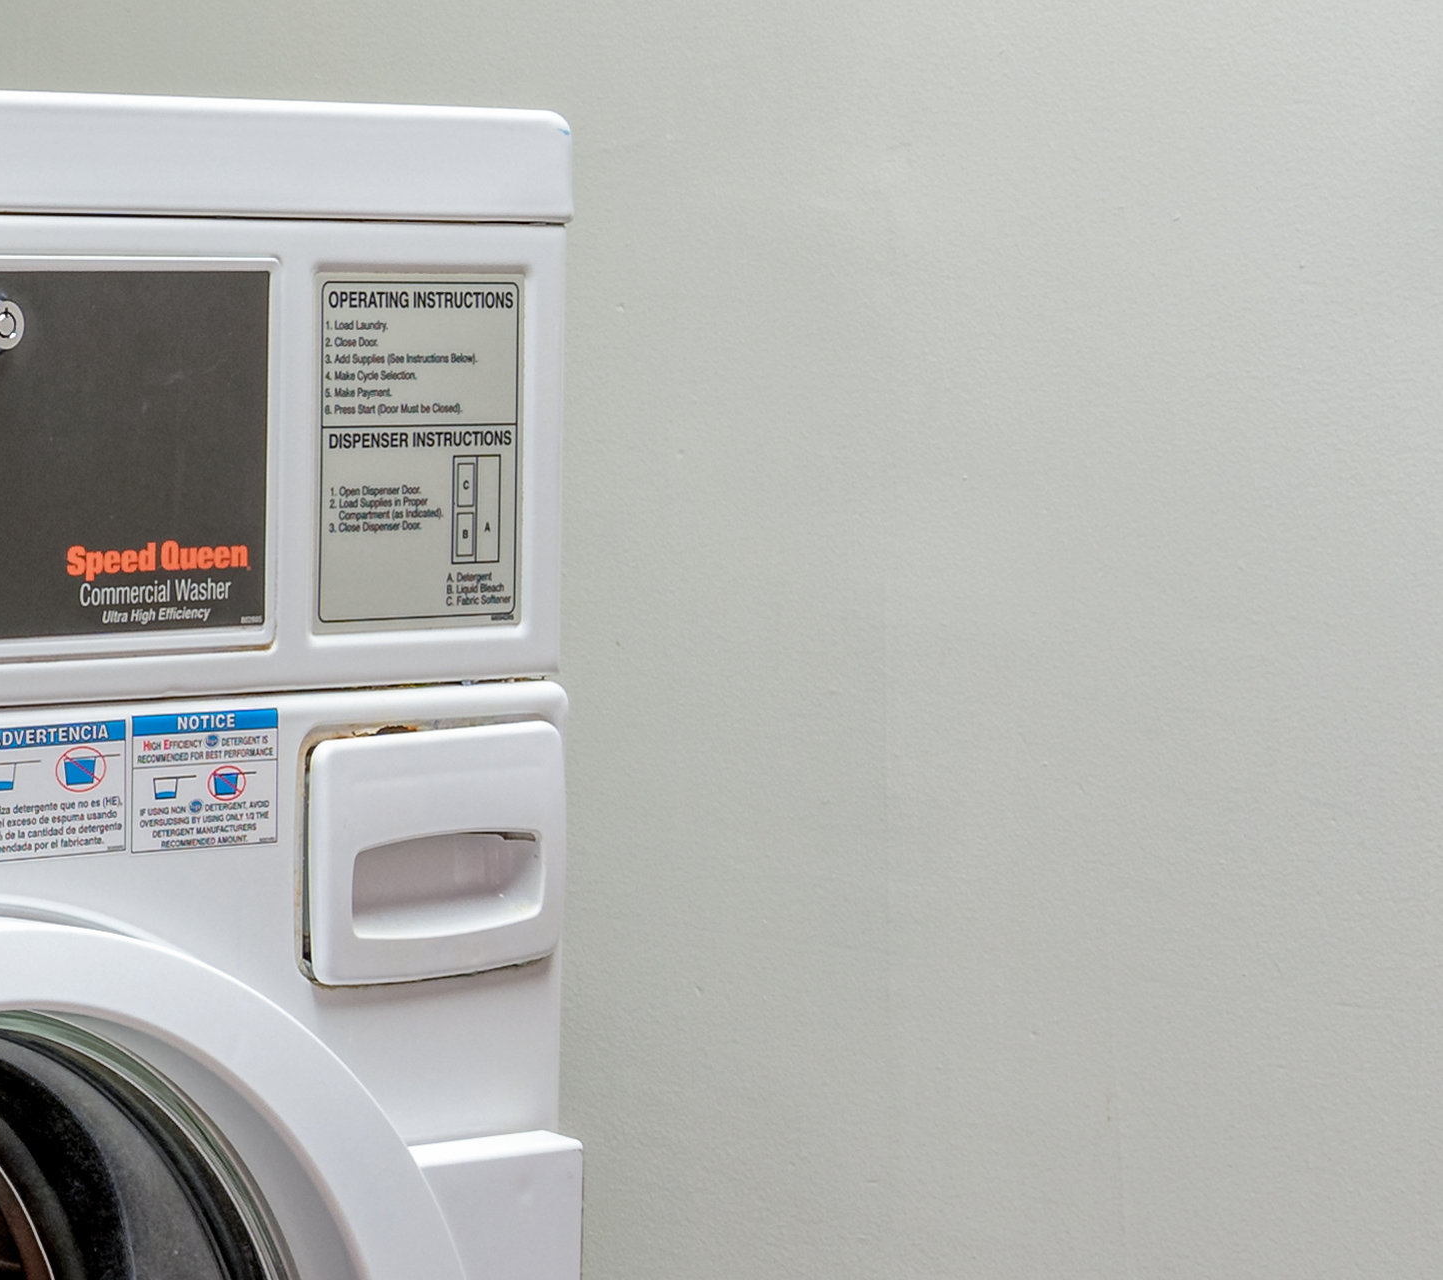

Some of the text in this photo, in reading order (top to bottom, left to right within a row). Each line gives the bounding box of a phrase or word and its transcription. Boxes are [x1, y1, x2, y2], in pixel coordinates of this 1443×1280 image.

[329, 291, 513, 309] OPERATING INSTRUCTIONS
[326, 321, 388, 332] 1. Load Laundry.
[325, 338, 332, 347] 2.
[335, 337, 356, 347] Close
[325, 355, 332, 364] 3.
[334, 354, 350, 364] Add
[352, 354, 385, 365] Supplies
[387, 354, 404, 365] (See
[407, 353, 449, 363] Instructions
[325, 372, 332, 380] 4.
[335, 371, 355, 380] Make
[357, 371, 378, 383] Cycle
[335, 388, 355, 397] Make
[335, 404, 355, 414] Press
[358, 404, 375, 414] Start
[378, 404, 398, 415] (Door
[401, 404, 419, 413] Must
[421, 404, 430, 413] be
[329, 431, 512, 449] DISPENSER INSTRUCTIONS
[463, 481, 469, 489] C
[339, 487, 360, 497] Open
[362, 486, 400, 497] Dispenser
[330, 498, 428, 509] 2. Load Supplies in Proper
[339, 511, 390, 521] Compartment
[329, 524, 337, 533] 3.
[339, 523, 360, 533] Close
[363, 522, 400, 533] Dispenser
[485, 523, 490, 532] A
[463, 530, 468, 539] B
[66, 540, 248, 581] Speed Queen
[447, 572, 492, 583] A. Detergent
[79, 578, 231, 606] Commercial Washer
[447, 583, 504, 595] B. Liquid Bleach
[446, 595, 511, 606] C. Fabric Softener
[102, 607, 210, 624] Ultra High Efficiency
[177, 714, 235, 730] NOTICE
